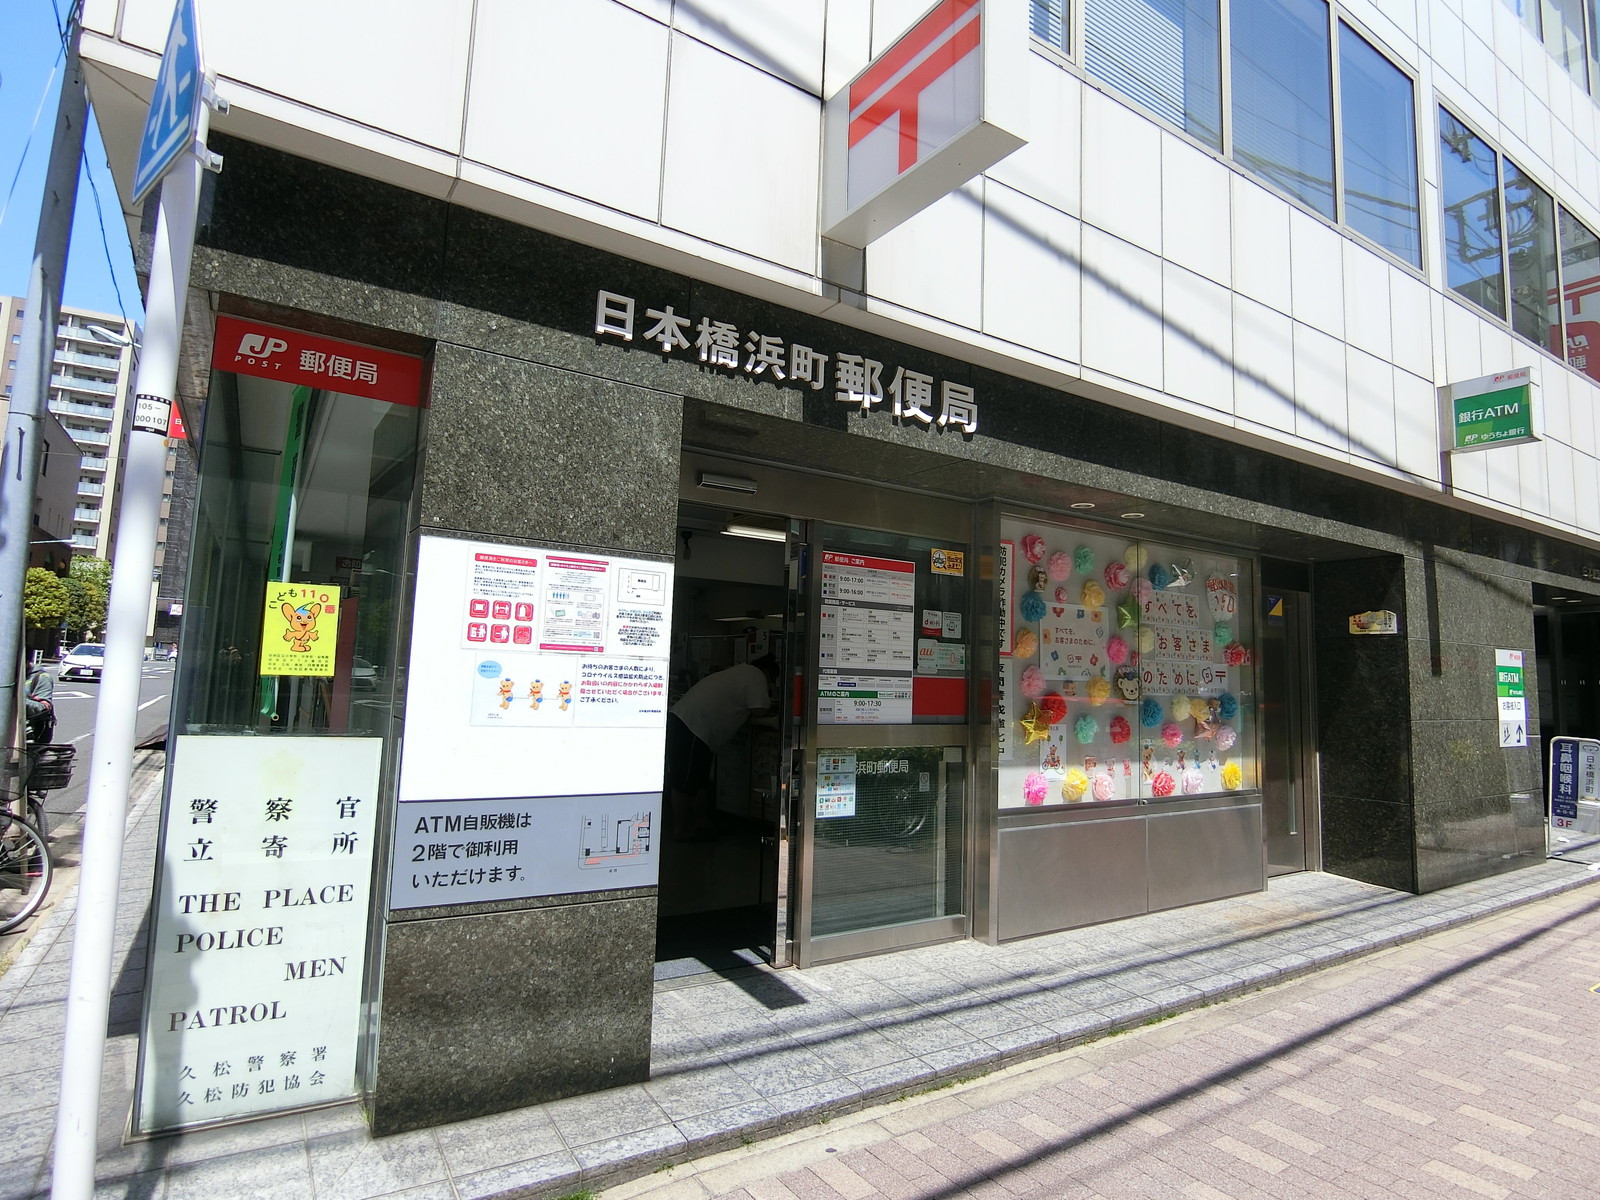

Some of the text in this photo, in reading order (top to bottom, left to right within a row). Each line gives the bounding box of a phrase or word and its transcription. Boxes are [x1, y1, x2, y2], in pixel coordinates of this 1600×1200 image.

[237, 333, 288, 359] JP
[234, 354, 282, 371] POST
[299, 349, 378, 385] 郵便局
[594, 288, 979, 434] 日本橋浜町郵便局
[1458, 402, 1519, 424] 銀行ATM
[1480, 426, 1526, 441] ゆうちょ銀行
[840, 575, 864, 584] 9:00-17:00
[1144, 600, 1198, 619] すべてを、
[1158, 636, 1210, 653] お客さま
[1143, 669, 1199, 686] のために。
[1498, 671, 1520, 683] 銀行ATM
[1559, 742, 1573, 795] 耳鼻咽喉科
[1585, 755, 1595, 795] 日本橋浜町
[189, 795, 361, 825] 警察官
[414, 811, 533, 835] ATM自販機は
[1556, 818, 1573, 828] 3F
[183, 831, 359, 862] 立寄所
[411, 839, 519, 862] 2階で御利用
[411, 865, 526, 889] いただけます。
[178, 883, 354, 915] THE PLACE
[174, 926, 284, 954] POLICE
[283, 956, 347, 982] MEN
[167, 1000, 287, 1032] PATROL
[178, 1046, 327, 1082] 久松警察署
[176, 1070, 326, 1108] 久松防犯協会
